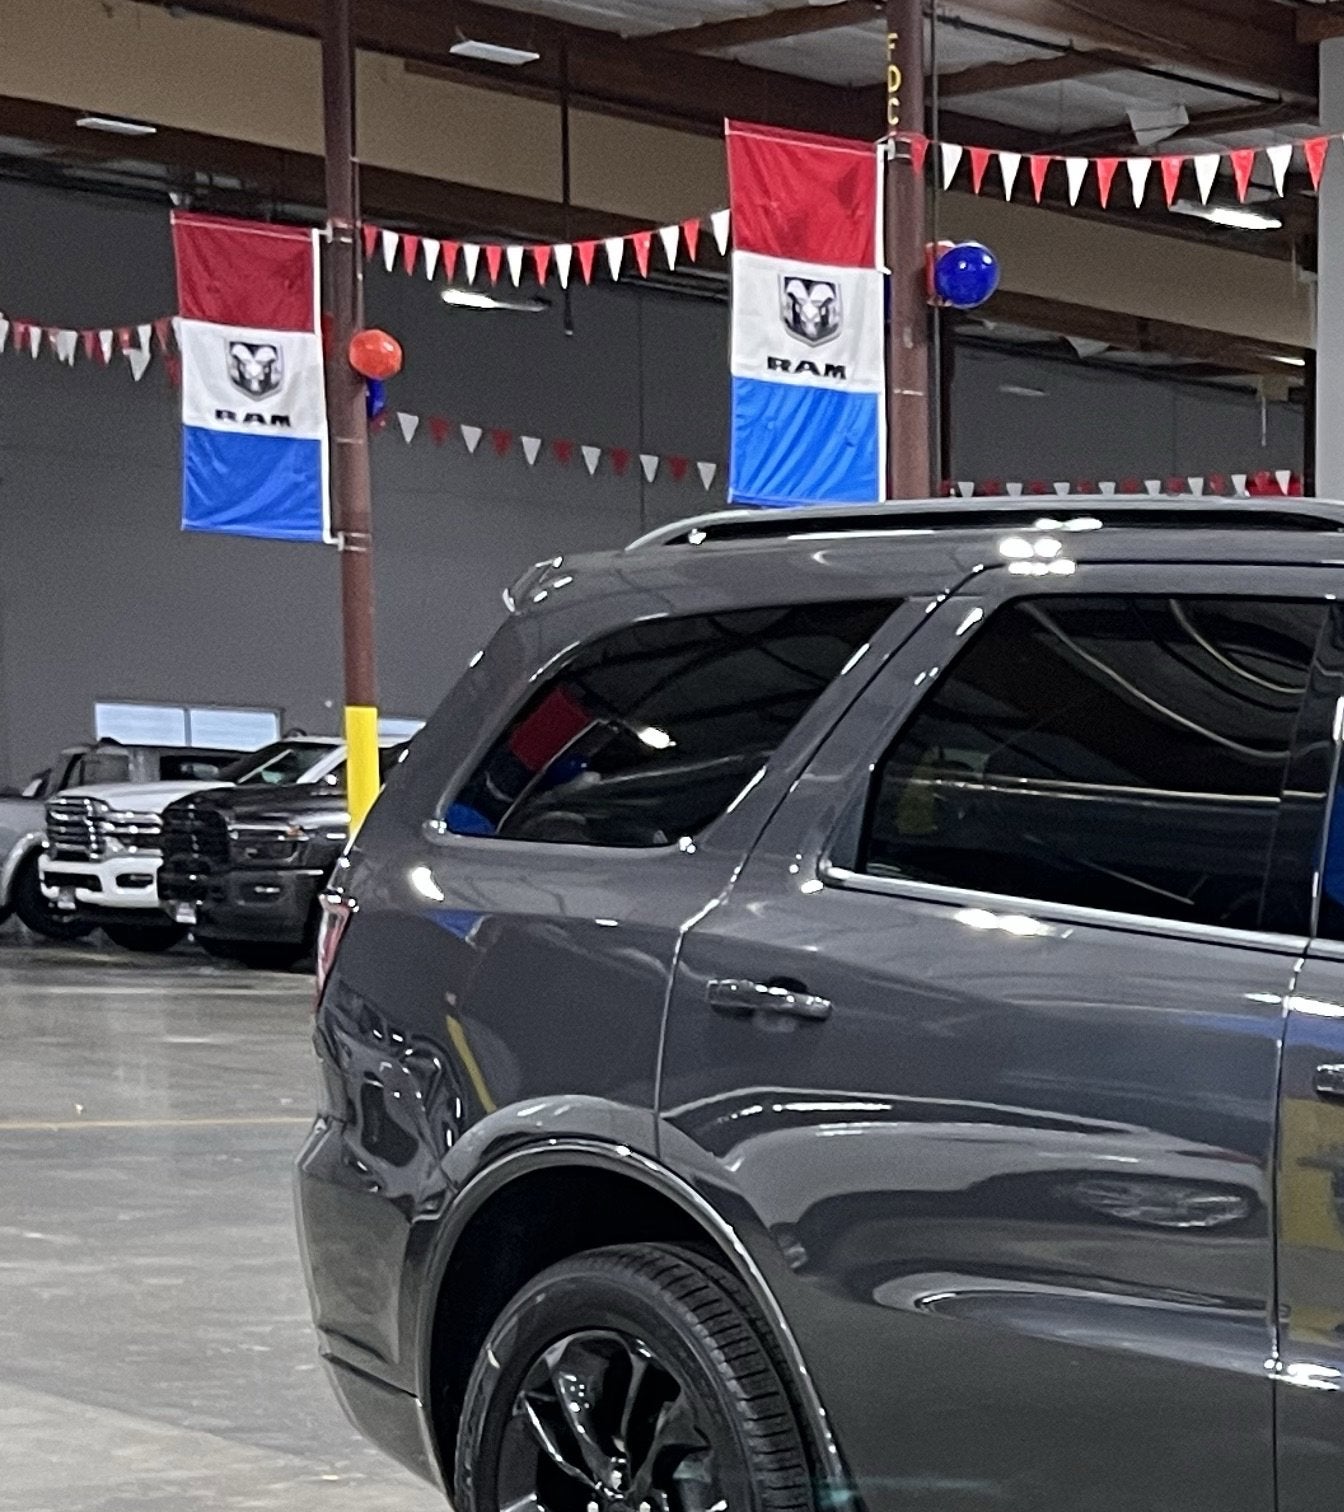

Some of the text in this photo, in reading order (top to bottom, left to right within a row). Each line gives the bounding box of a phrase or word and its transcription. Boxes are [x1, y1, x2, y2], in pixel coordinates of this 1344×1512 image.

[886, 32, 902, 126] FDC
[767, 356, 847, 380] RAM
[215, 409, 291, 428] RAM
